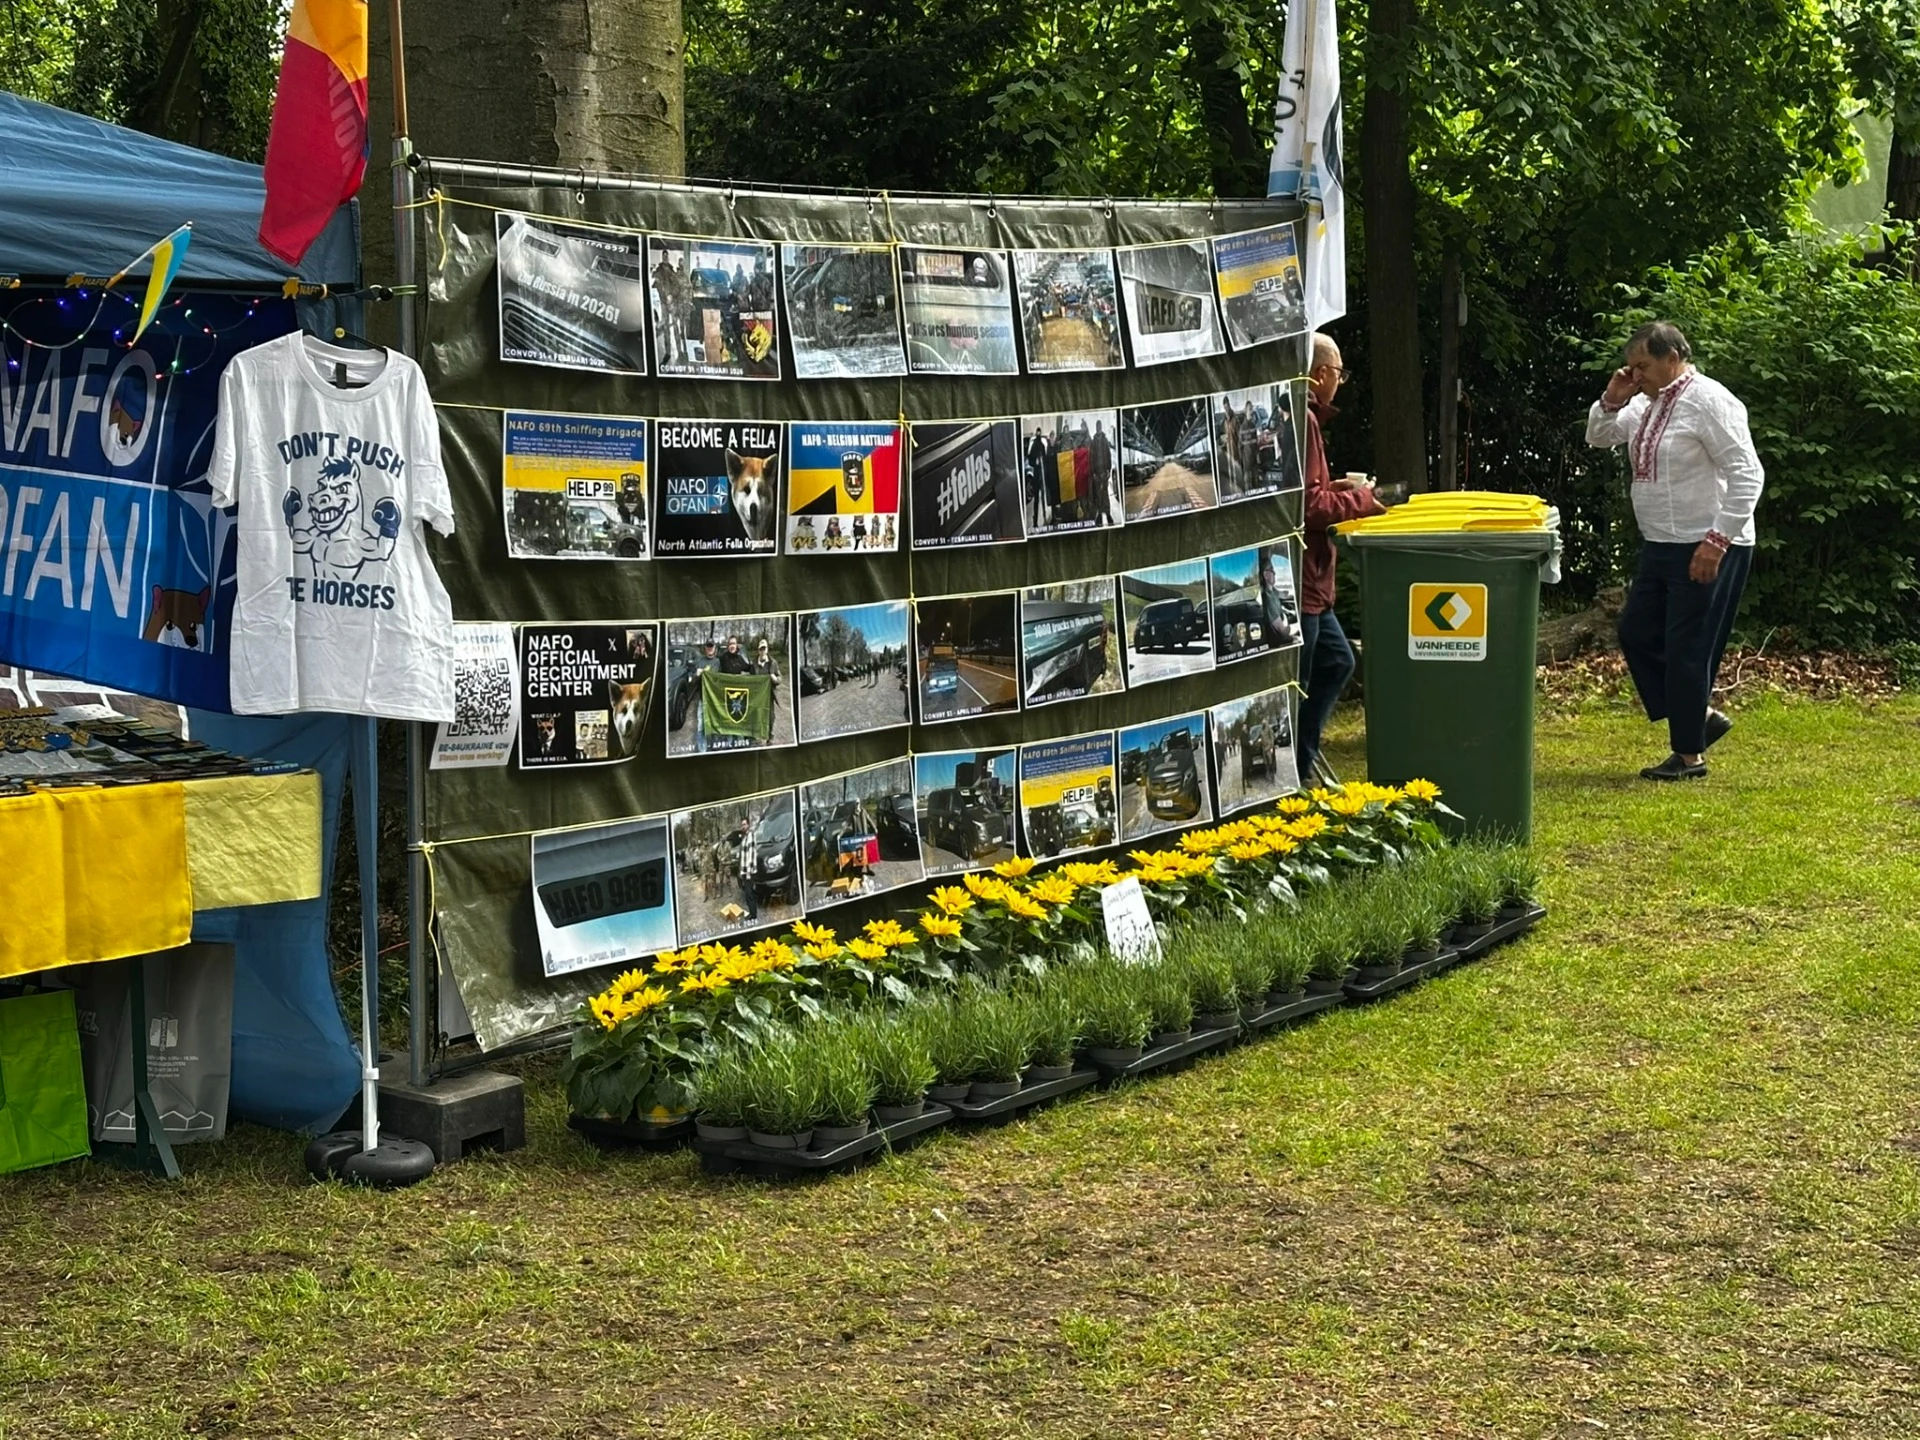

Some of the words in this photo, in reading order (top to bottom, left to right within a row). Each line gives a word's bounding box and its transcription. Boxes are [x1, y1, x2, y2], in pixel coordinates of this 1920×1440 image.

[1254, 279, 1275, 295] HELP
[533, 275, 566, 300] Russia
[567, 289, 580, 307] in
[581, 295, 621, 325] 2026!
[946, 323, 979, 340] hunting
[980, 326, 1010, 338] season
[505, 348, 537, 359] CONVOY
[553, 354, 588, 365] FEBRUARI
[660, 364, 686, 373] CONVOY
[508, 420, 535, 431] NAFO
[538, 422, 561, 434] 69th
[564, 424, 603, 437] Sniffing
[606, 426, 643, 439] Brigade
[661, 427, 723, 448] BECOME
[728, 428, 738, 448] A
[742, 428, 776, 449] FELLA
[802, 434, 820, 446] NAFO
[827, 434, 859, 446] BELGIUM
[860, 434, 894, 446] BATTALION
[277, 431, 340, 465] DON'T
[347, 436, 405, 478] PUSH
[568, 481, 601, 497] HELP
[667, 478, 706, 495] NAFO
[937, 449, 991, 526] #fellas
[667, 497, 707, 513] OFAN
[658, 539, 685, 551] North
[688, 538, 723, 550] Atlantic
[725, 538, 743, 549] Fella
[951, 535, 978, 543] FEBRUARI
[0, 483, 140, 619] FAN
[313, 579, 396, 611] HORSES
[528, 634, 573, 650] NAFO
[608, 638, 617, 651] X
[1415, 641, 1480, 650] VANHEEDE
[528, 650, 600, 666] OFFICIAL
[528, 664, 636, 682] RECRUITMENT
[528, 681, 592, 698] CENTER
[924, 712, 945, 720] CONVOY
[957, 708, 969, 716] APRIL
[713, 741, 732, 749] APRIL
[1023, 751, 1041, 760] NAFO
[1042, 748, 1058, 757] 69th
[1086, 740, 1111, 750] Brigade
[460, 753, 475, 761] onze
[1062, 788, 1085, 804] HELP
[547, 880, 604, 922] NAFO
[607, 868, 658, 908] 986
